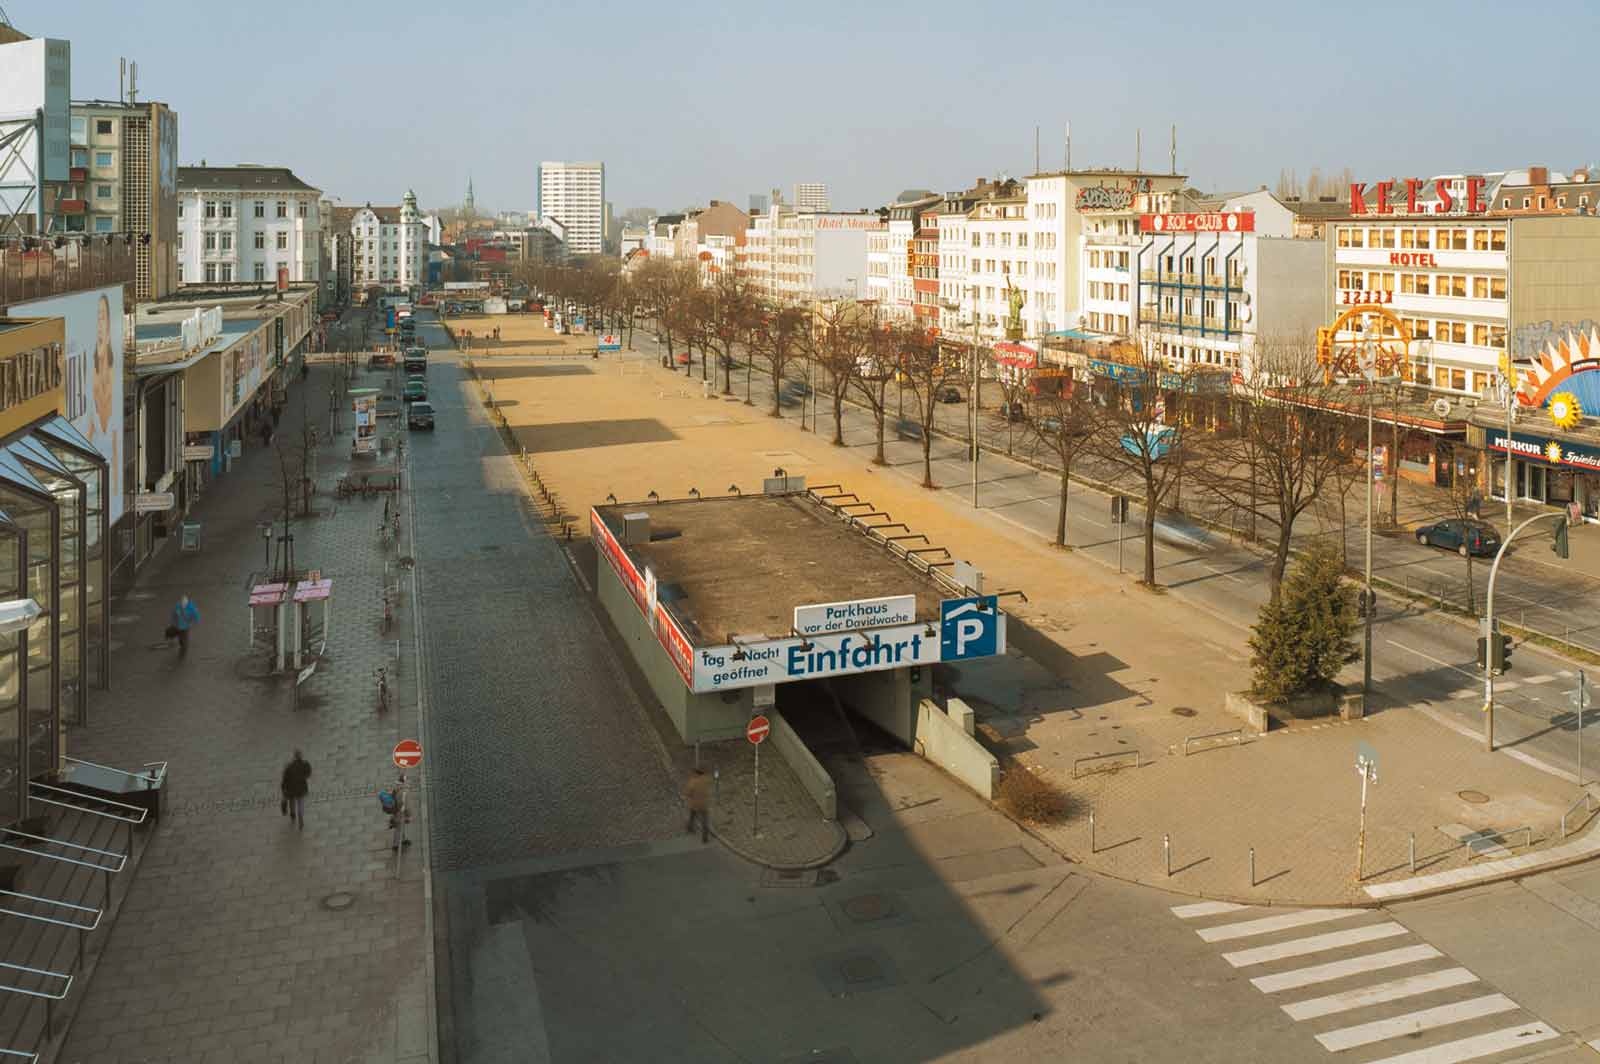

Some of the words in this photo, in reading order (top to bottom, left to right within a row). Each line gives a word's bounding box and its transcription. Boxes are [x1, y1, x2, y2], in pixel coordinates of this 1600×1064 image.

[1350, 176, 1487, 214] KEESE
[1390, 252, 1437, 267] HOTEL
[1495, 437, 1541, 455] MERKUR
[826, 603, 888, 619] Parkhaus
[804, 623, 823, 633] vor
[825, 618, 843, 631] der
[845, 612, 909, 628] Davidwache
[956, 619, 984, 656] P
[702, 651, 725, 668] Tag
[743, 647, 779, 662] Nacht
[787, 634, 921, 676] Einfahrt
[712, 666, 769, 685] geöffnet
